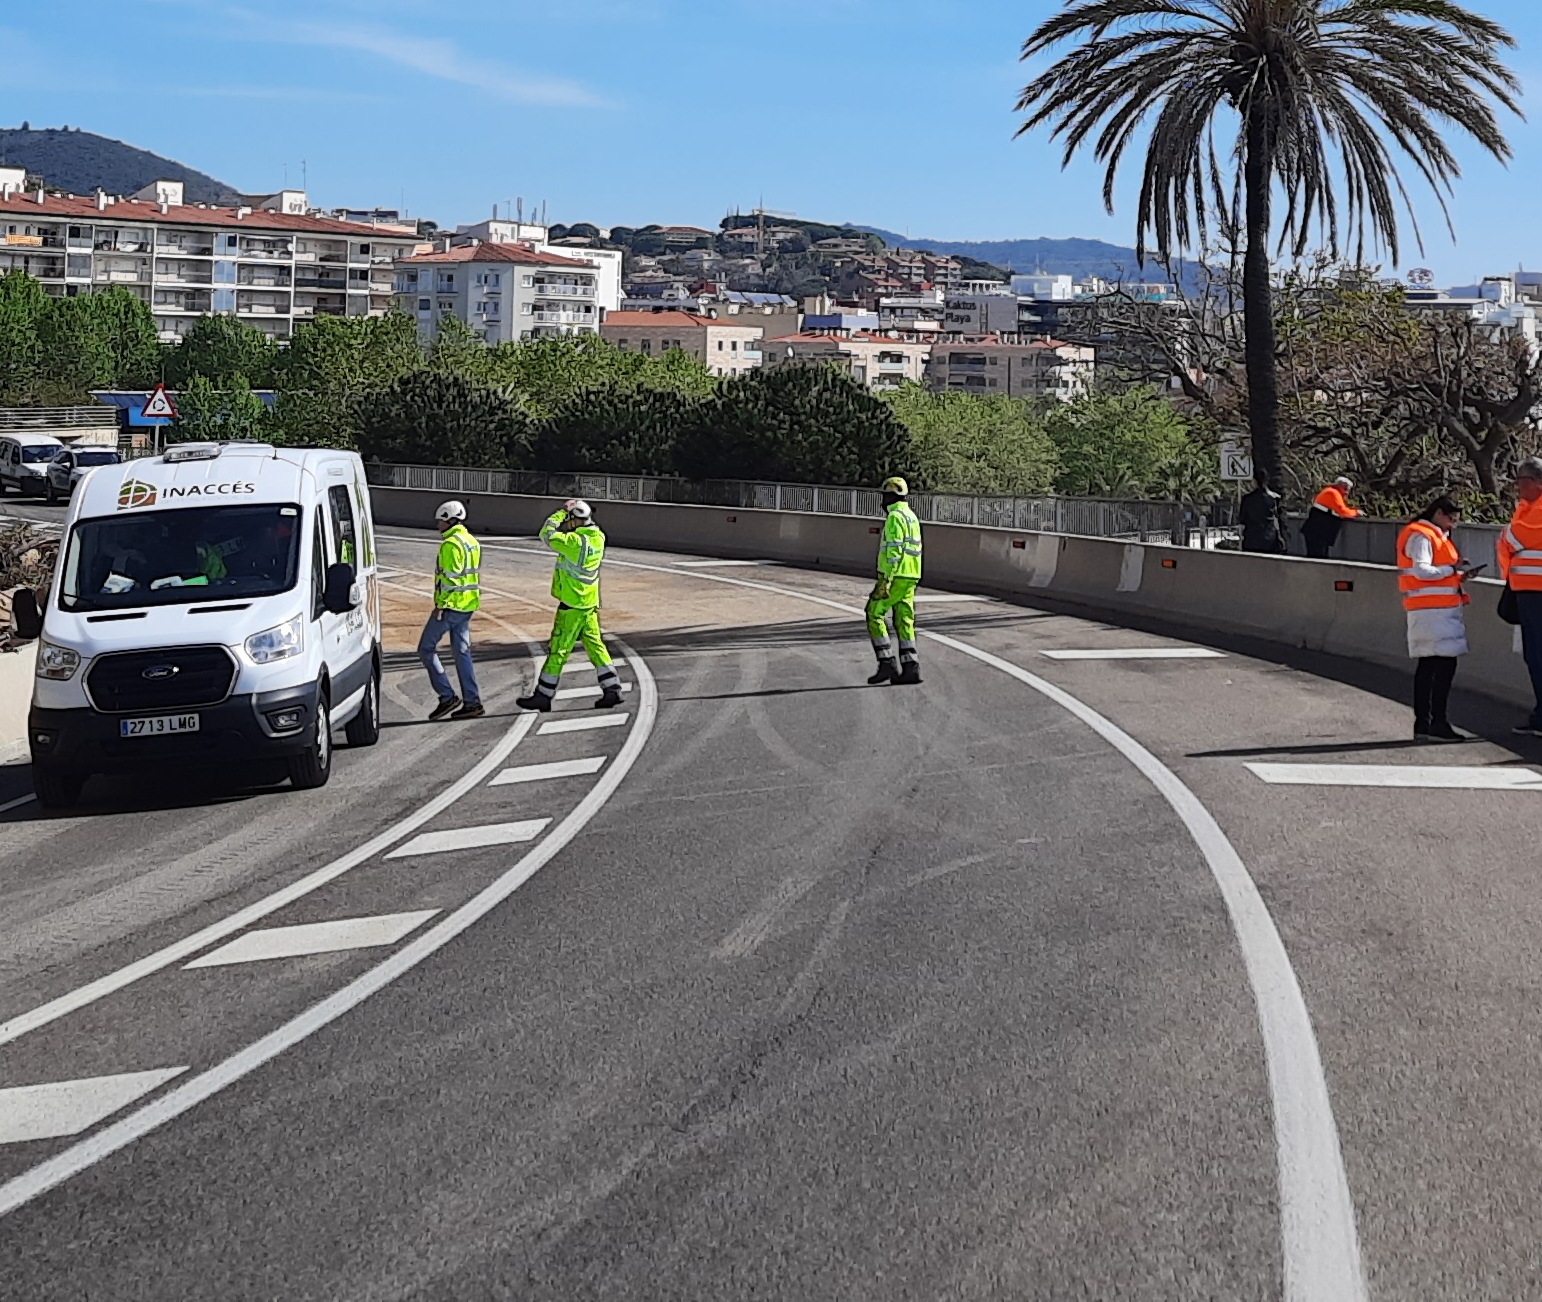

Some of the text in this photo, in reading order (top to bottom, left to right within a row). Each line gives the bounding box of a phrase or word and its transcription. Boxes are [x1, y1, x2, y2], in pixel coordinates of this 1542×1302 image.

[945, 300, 977, 310] Kaktus
[945, 312, 971, 324] Playa
[162, 481, 255, 498] INACCÉS
[130, 716, 195, 734] 2713 LMG
